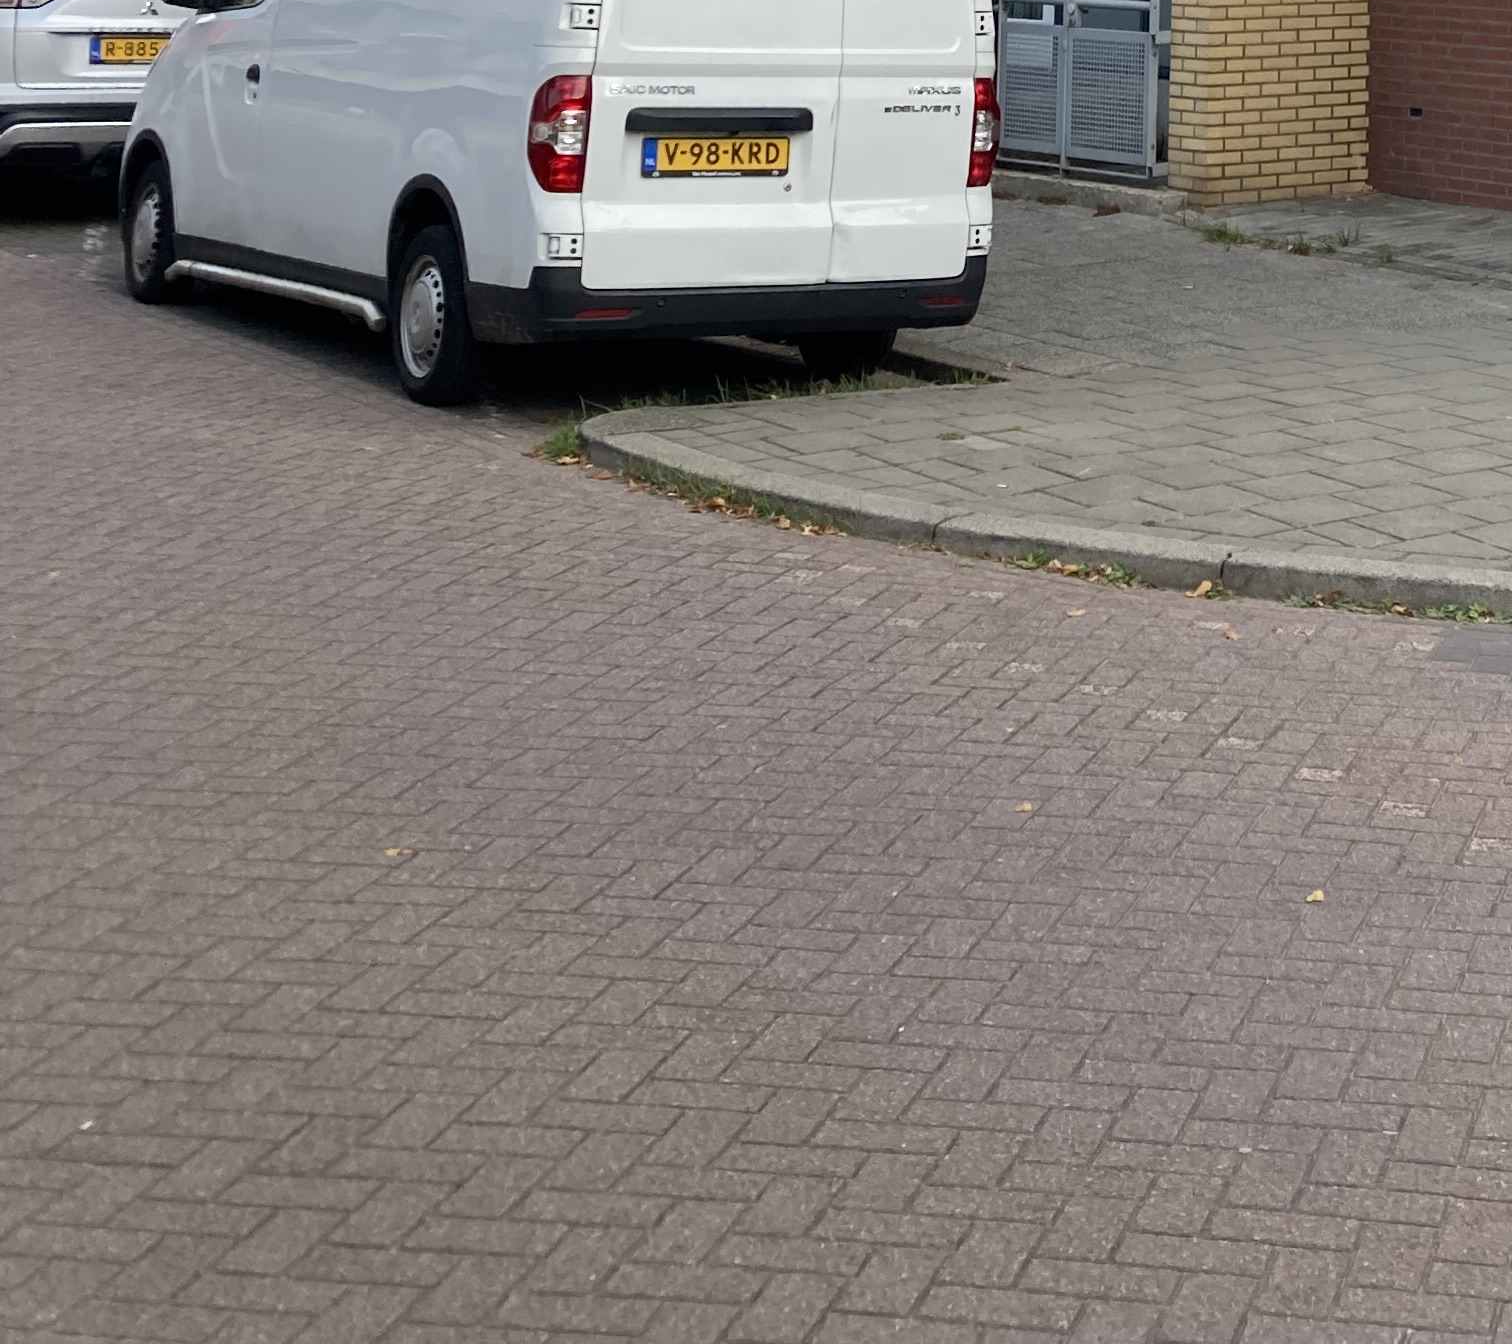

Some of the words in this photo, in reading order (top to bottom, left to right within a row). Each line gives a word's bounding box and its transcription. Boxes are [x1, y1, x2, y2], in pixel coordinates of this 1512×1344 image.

[105, 41, 160, 57] R-885
[648, 85, 696, 96] MOTOR
[664, 142, 780, 166] V-98-KRD
